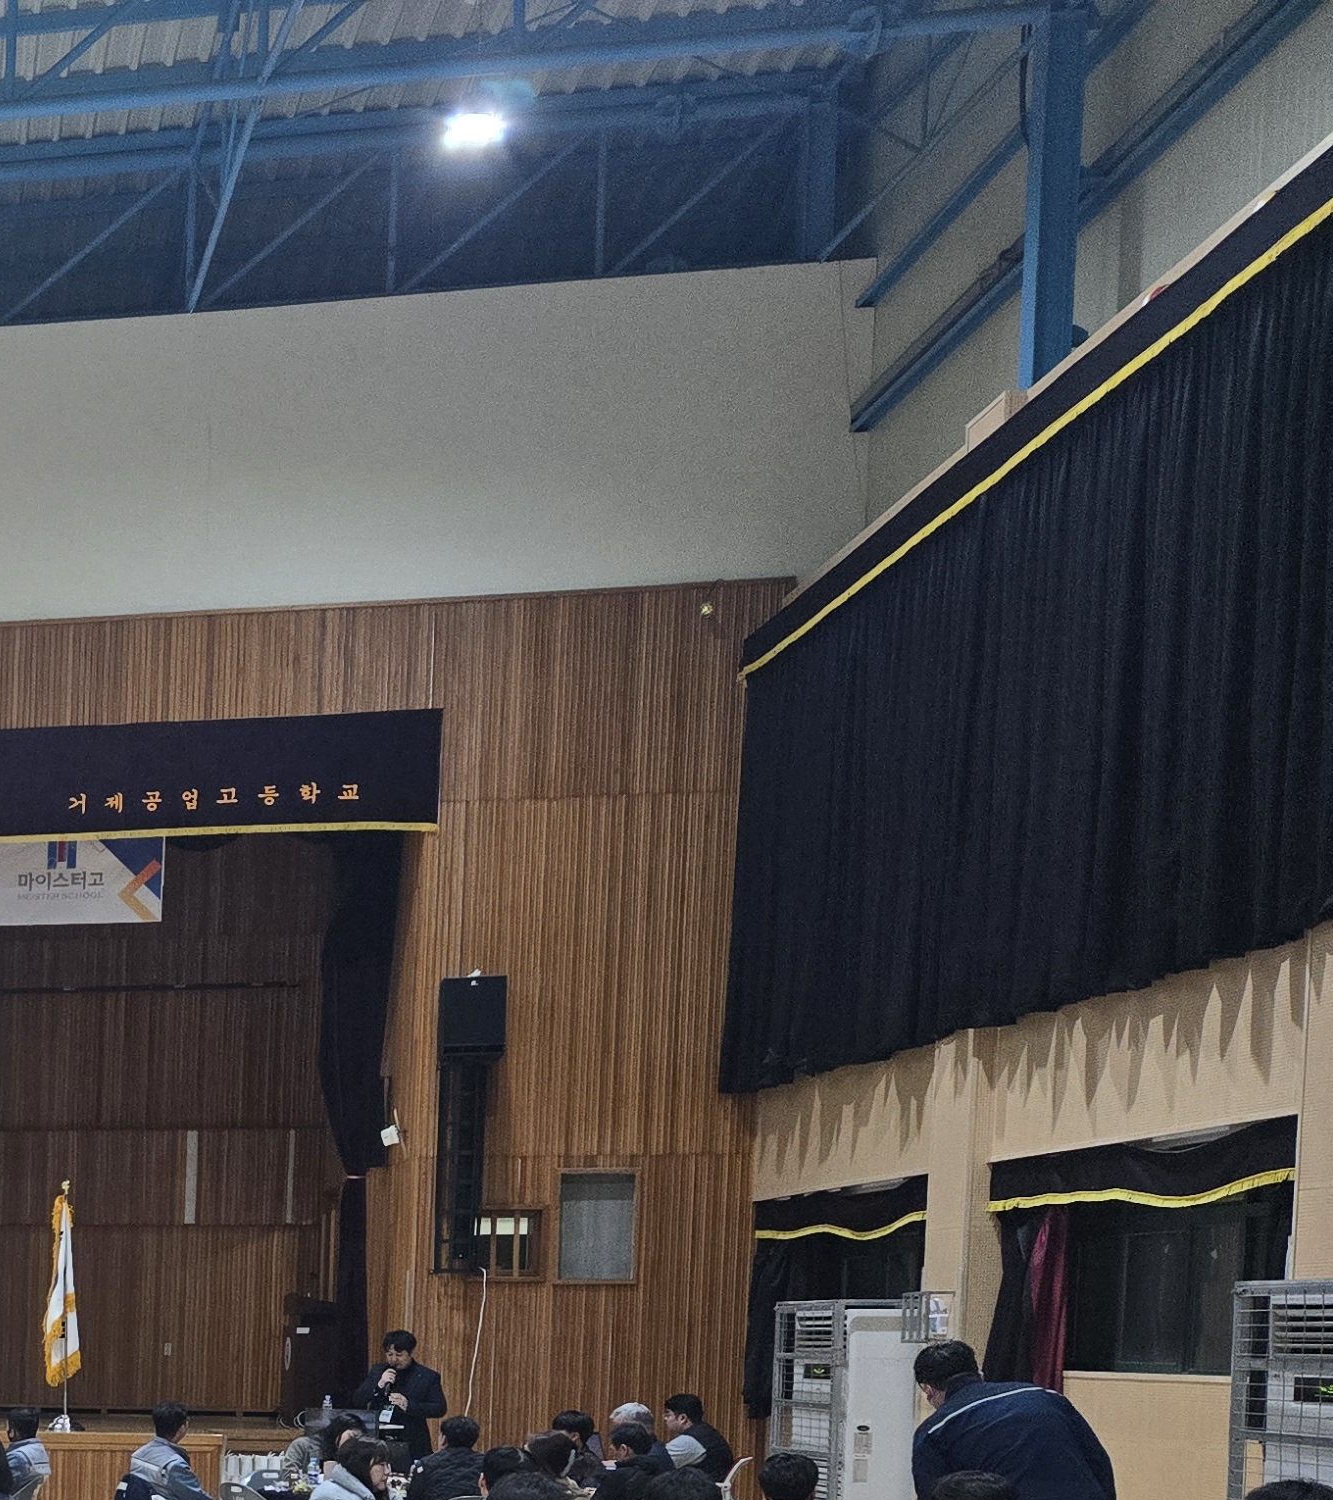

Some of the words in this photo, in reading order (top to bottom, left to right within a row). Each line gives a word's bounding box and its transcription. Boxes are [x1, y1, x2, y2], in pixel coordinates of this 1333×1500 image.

[68, 781, 360, 814] 거제공업고등학교
[17, 870, 106, 891] 마이스터고
[61, 891, 104, 900] SCHOOL
